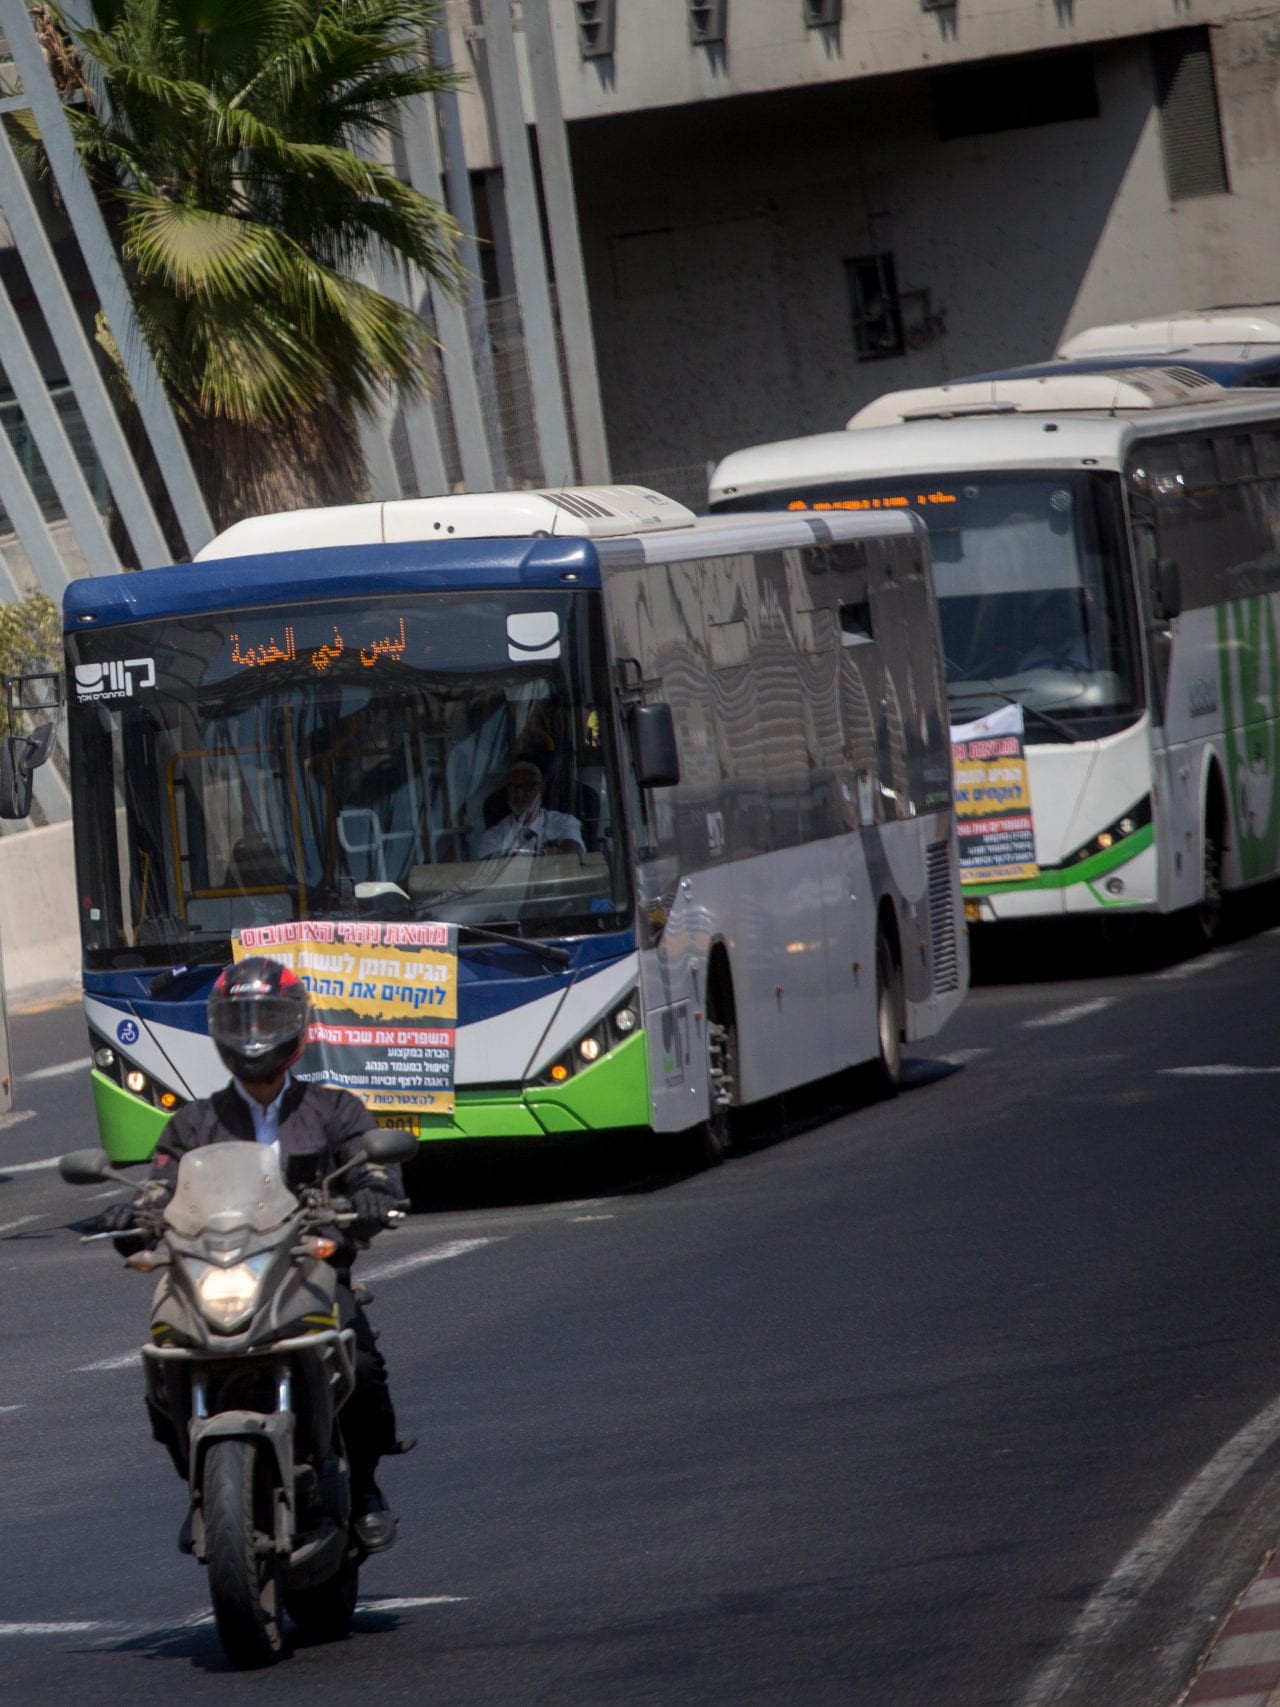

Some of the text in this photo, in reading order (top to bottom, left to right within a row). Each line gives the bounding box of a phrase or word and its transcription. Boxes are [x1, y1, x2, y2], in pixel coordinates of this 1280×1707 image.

[230, 618, 406, 670] ليس في الخدمة
[240, 921, 448, 948] מחאת נהגי האוטובוס
[298, 951, 355, 975] לעשות
[358, 958, 400, 981] הזמן
[404, 961, 448, 982] הגיע
[349, 980, 376, 999] את
[381, 985, 446, 1009] לוקחים
[345, 1030, 371, 1043] שכר
[375, 1031, 394, 1044] את
[397, 1032, 449, 1045] משפרים
[388, 1047, 450, 1059] הכרה במקצוע
[365, 1061, 450, 1072] טיפול במעמד הנהג
[370, 1075, 397, 1085] זכויות
[397, 1075, 423, 1088] לרצף
[374, 1093, 436, 1106] להצטרפות
